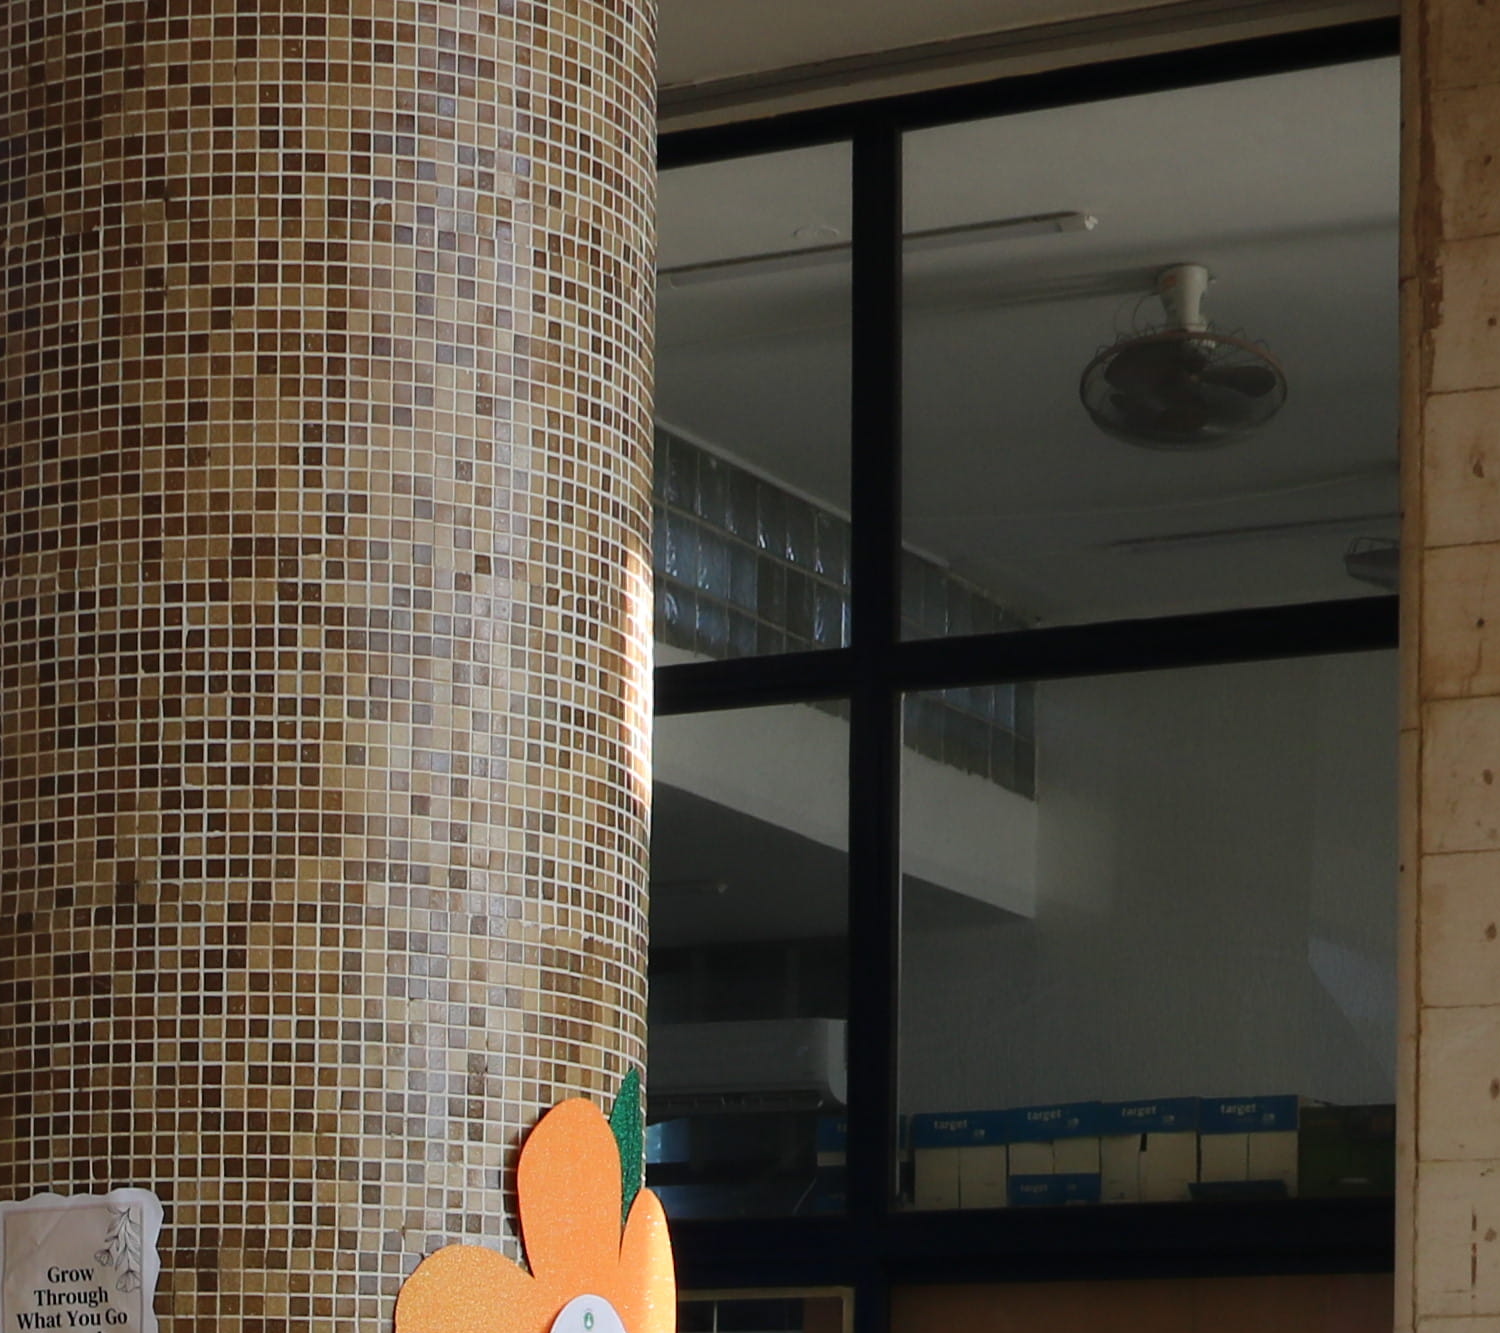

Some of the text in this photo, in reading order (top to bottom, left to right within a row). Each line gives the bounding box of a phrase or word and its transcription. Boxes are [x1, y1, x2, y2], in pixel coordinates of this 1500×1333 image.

[47, 1266, 95, 1283] Grow
[34, 1286, 109, 1308] Through
[16, 1308, 128, 1330] What You Go
